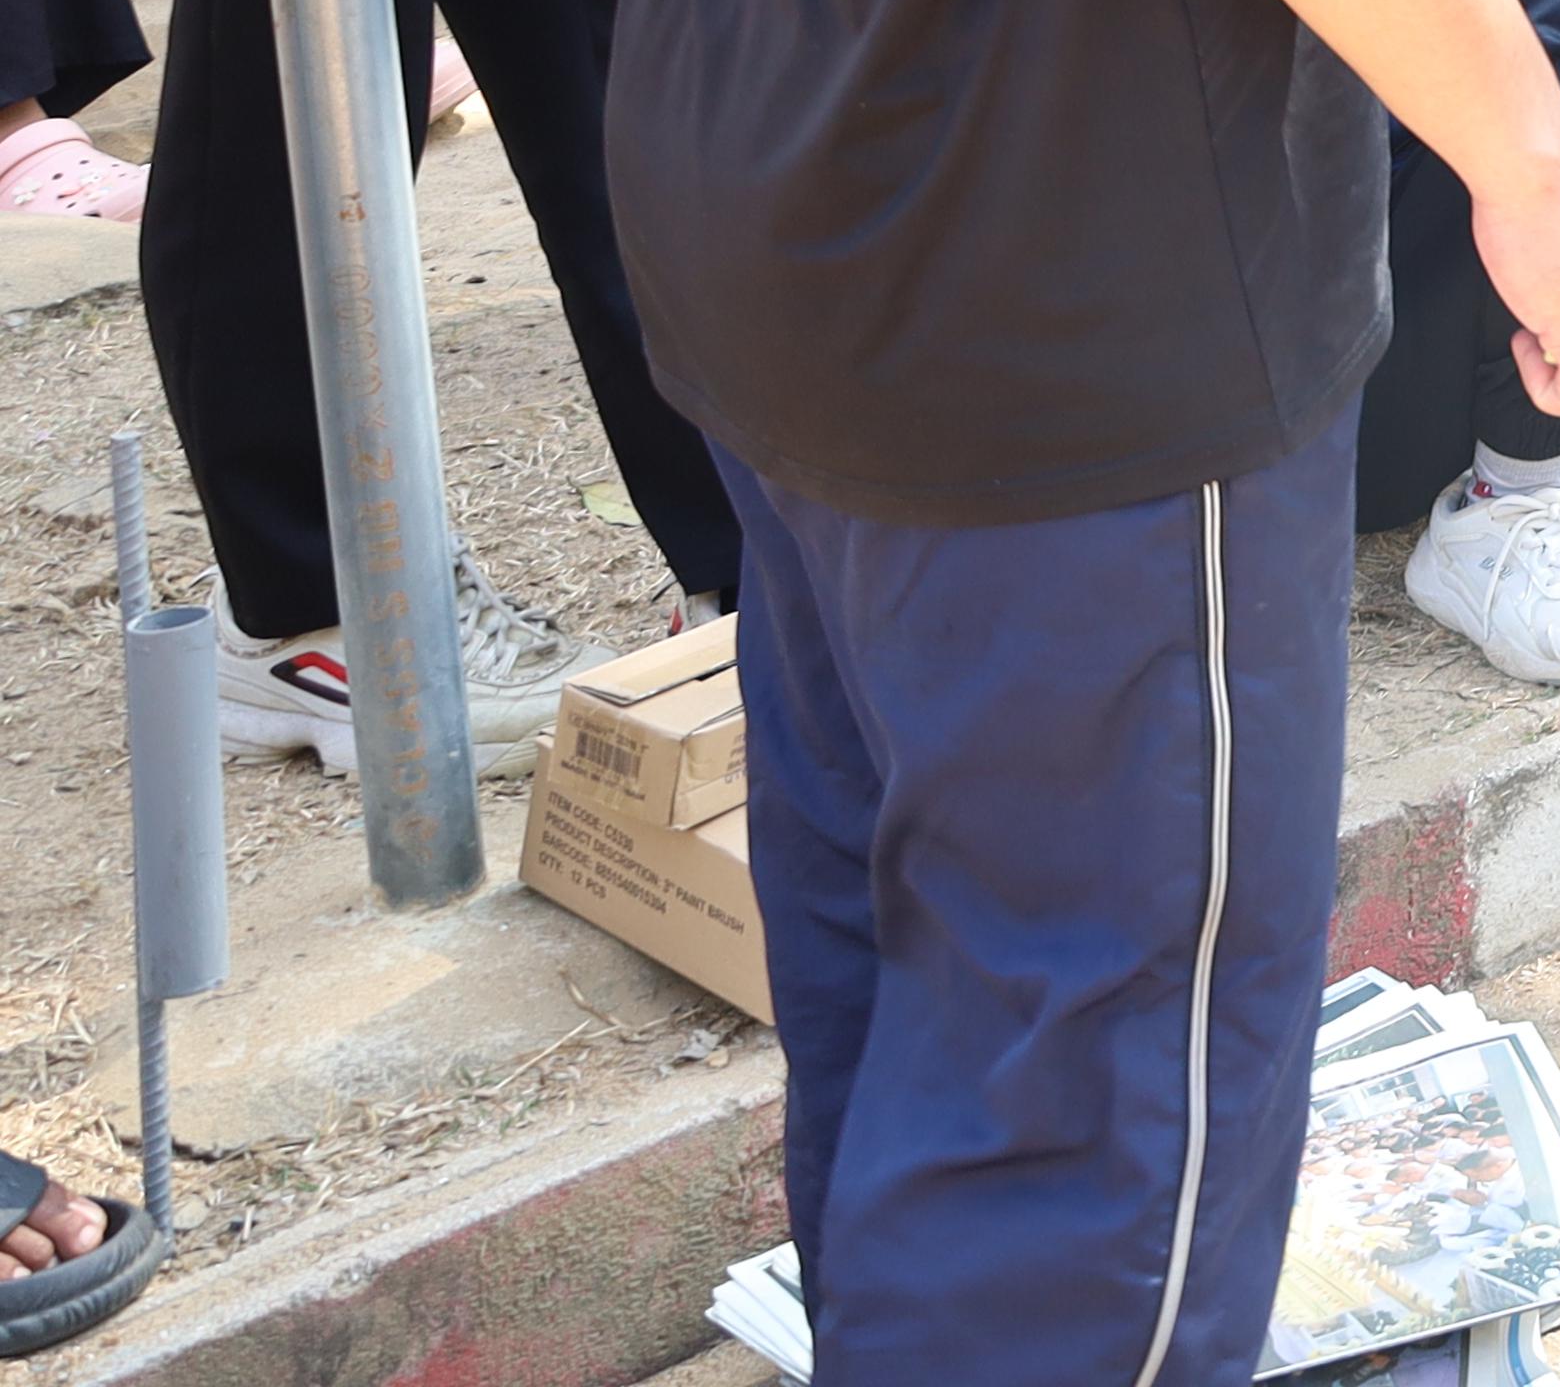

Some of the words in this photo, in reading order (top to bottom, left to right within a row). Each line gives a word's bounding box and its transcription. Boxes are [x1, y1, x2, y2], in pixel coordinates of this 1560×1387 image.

[544, 809, 592, 847] PRODUCT
[676, 885, 707, 913] PAINT
[708, 903, 745, 936] BRUSH
[585, 878, 608, 901] PCS
